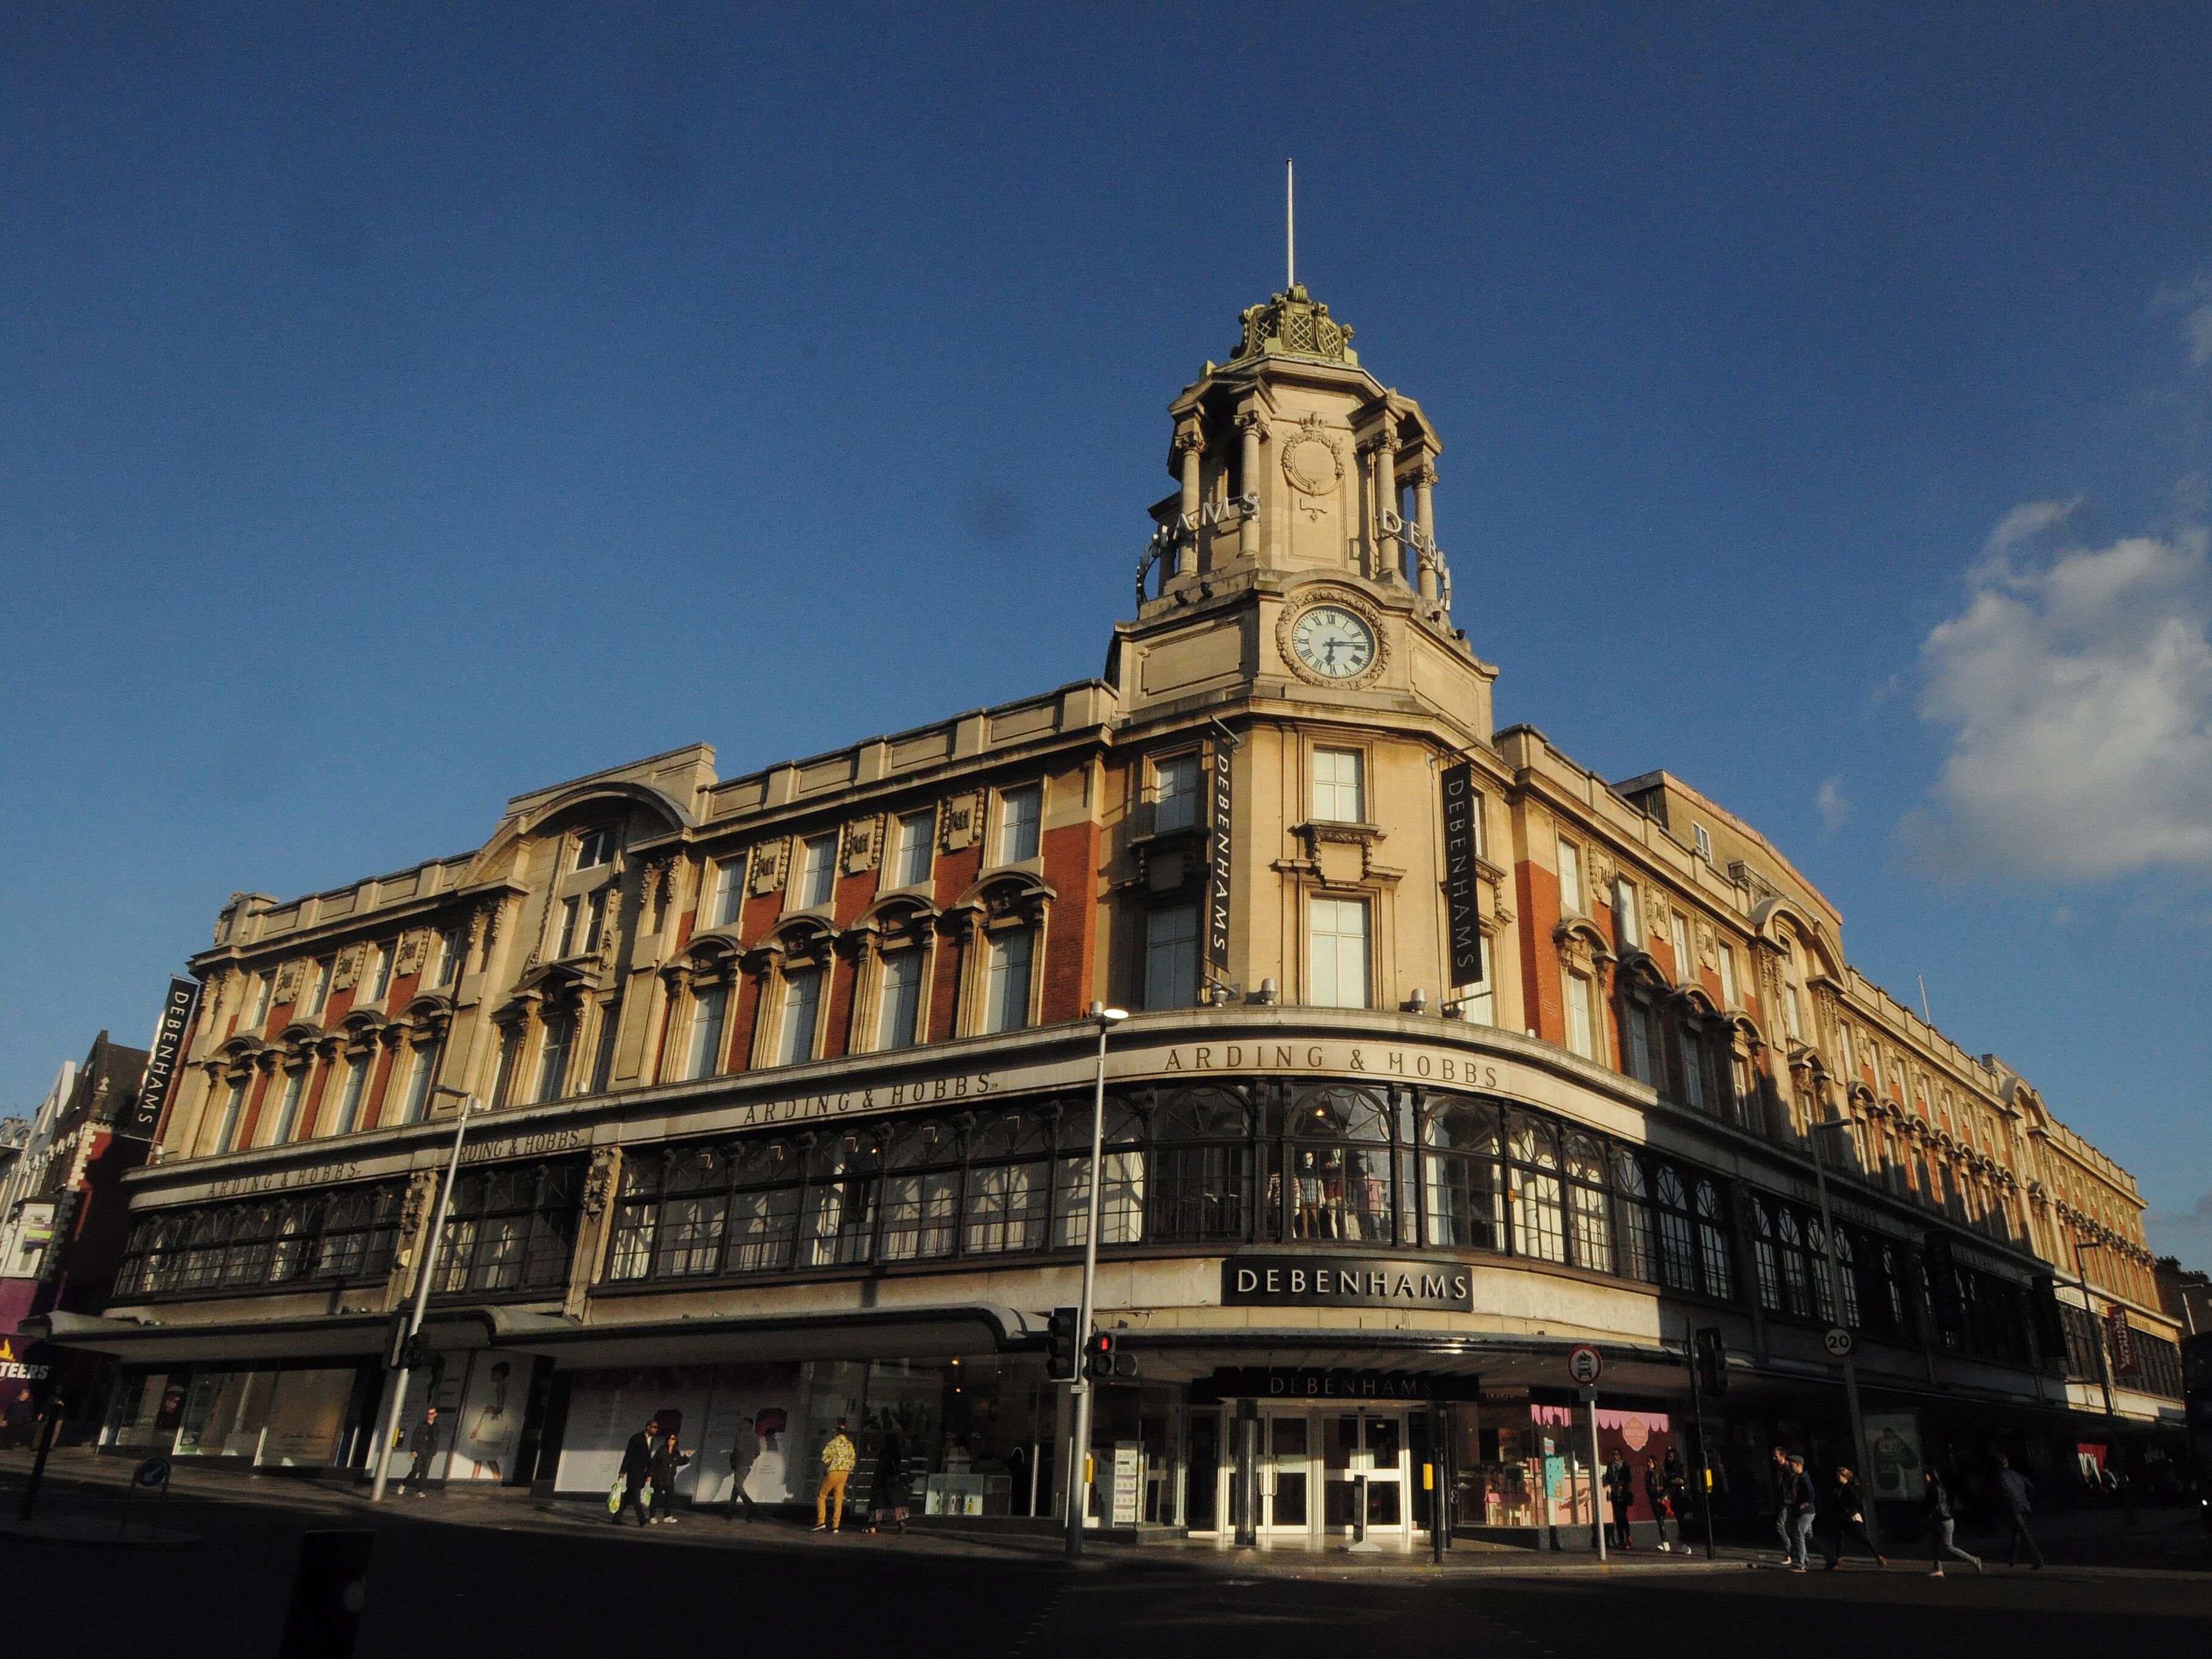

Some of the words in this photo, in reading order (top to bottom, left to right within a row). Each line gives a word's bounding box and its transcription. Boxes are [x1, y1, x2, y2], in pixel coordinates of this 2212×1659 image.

[1213, 753, 1230, 951] DEBENHAMS
[1448, 778, 1475, 969] DEBENHAMS
[139, 991, 189, 1125] DEBENHAMS
[1165, 1045, 1324, 1072] ARDING
[1350, 1049, 1366, 1072] &
[1389, 1052, 1497, 1087] HOBBS
[744, 1092, 850, 1124] ARDING
[862, 1089, 874, 1108] &
[890, 1072, 990, 1105] HOBBS
[508, 1138, 518, 1155] &
[524, 1129, 579, 1154] HOBBS
[207, 1174, 272, 1197] ARDING
[297, 1162, 358, 1185] HOBBS
[1237, 1269, 1467, 1300] DEBENHAMS
[1828, 1336, 1849, 1349] 20
[0, 1362, 50, 1379] TEERS
[1271, 1377, 1432, 1396] DEBENHAMS
